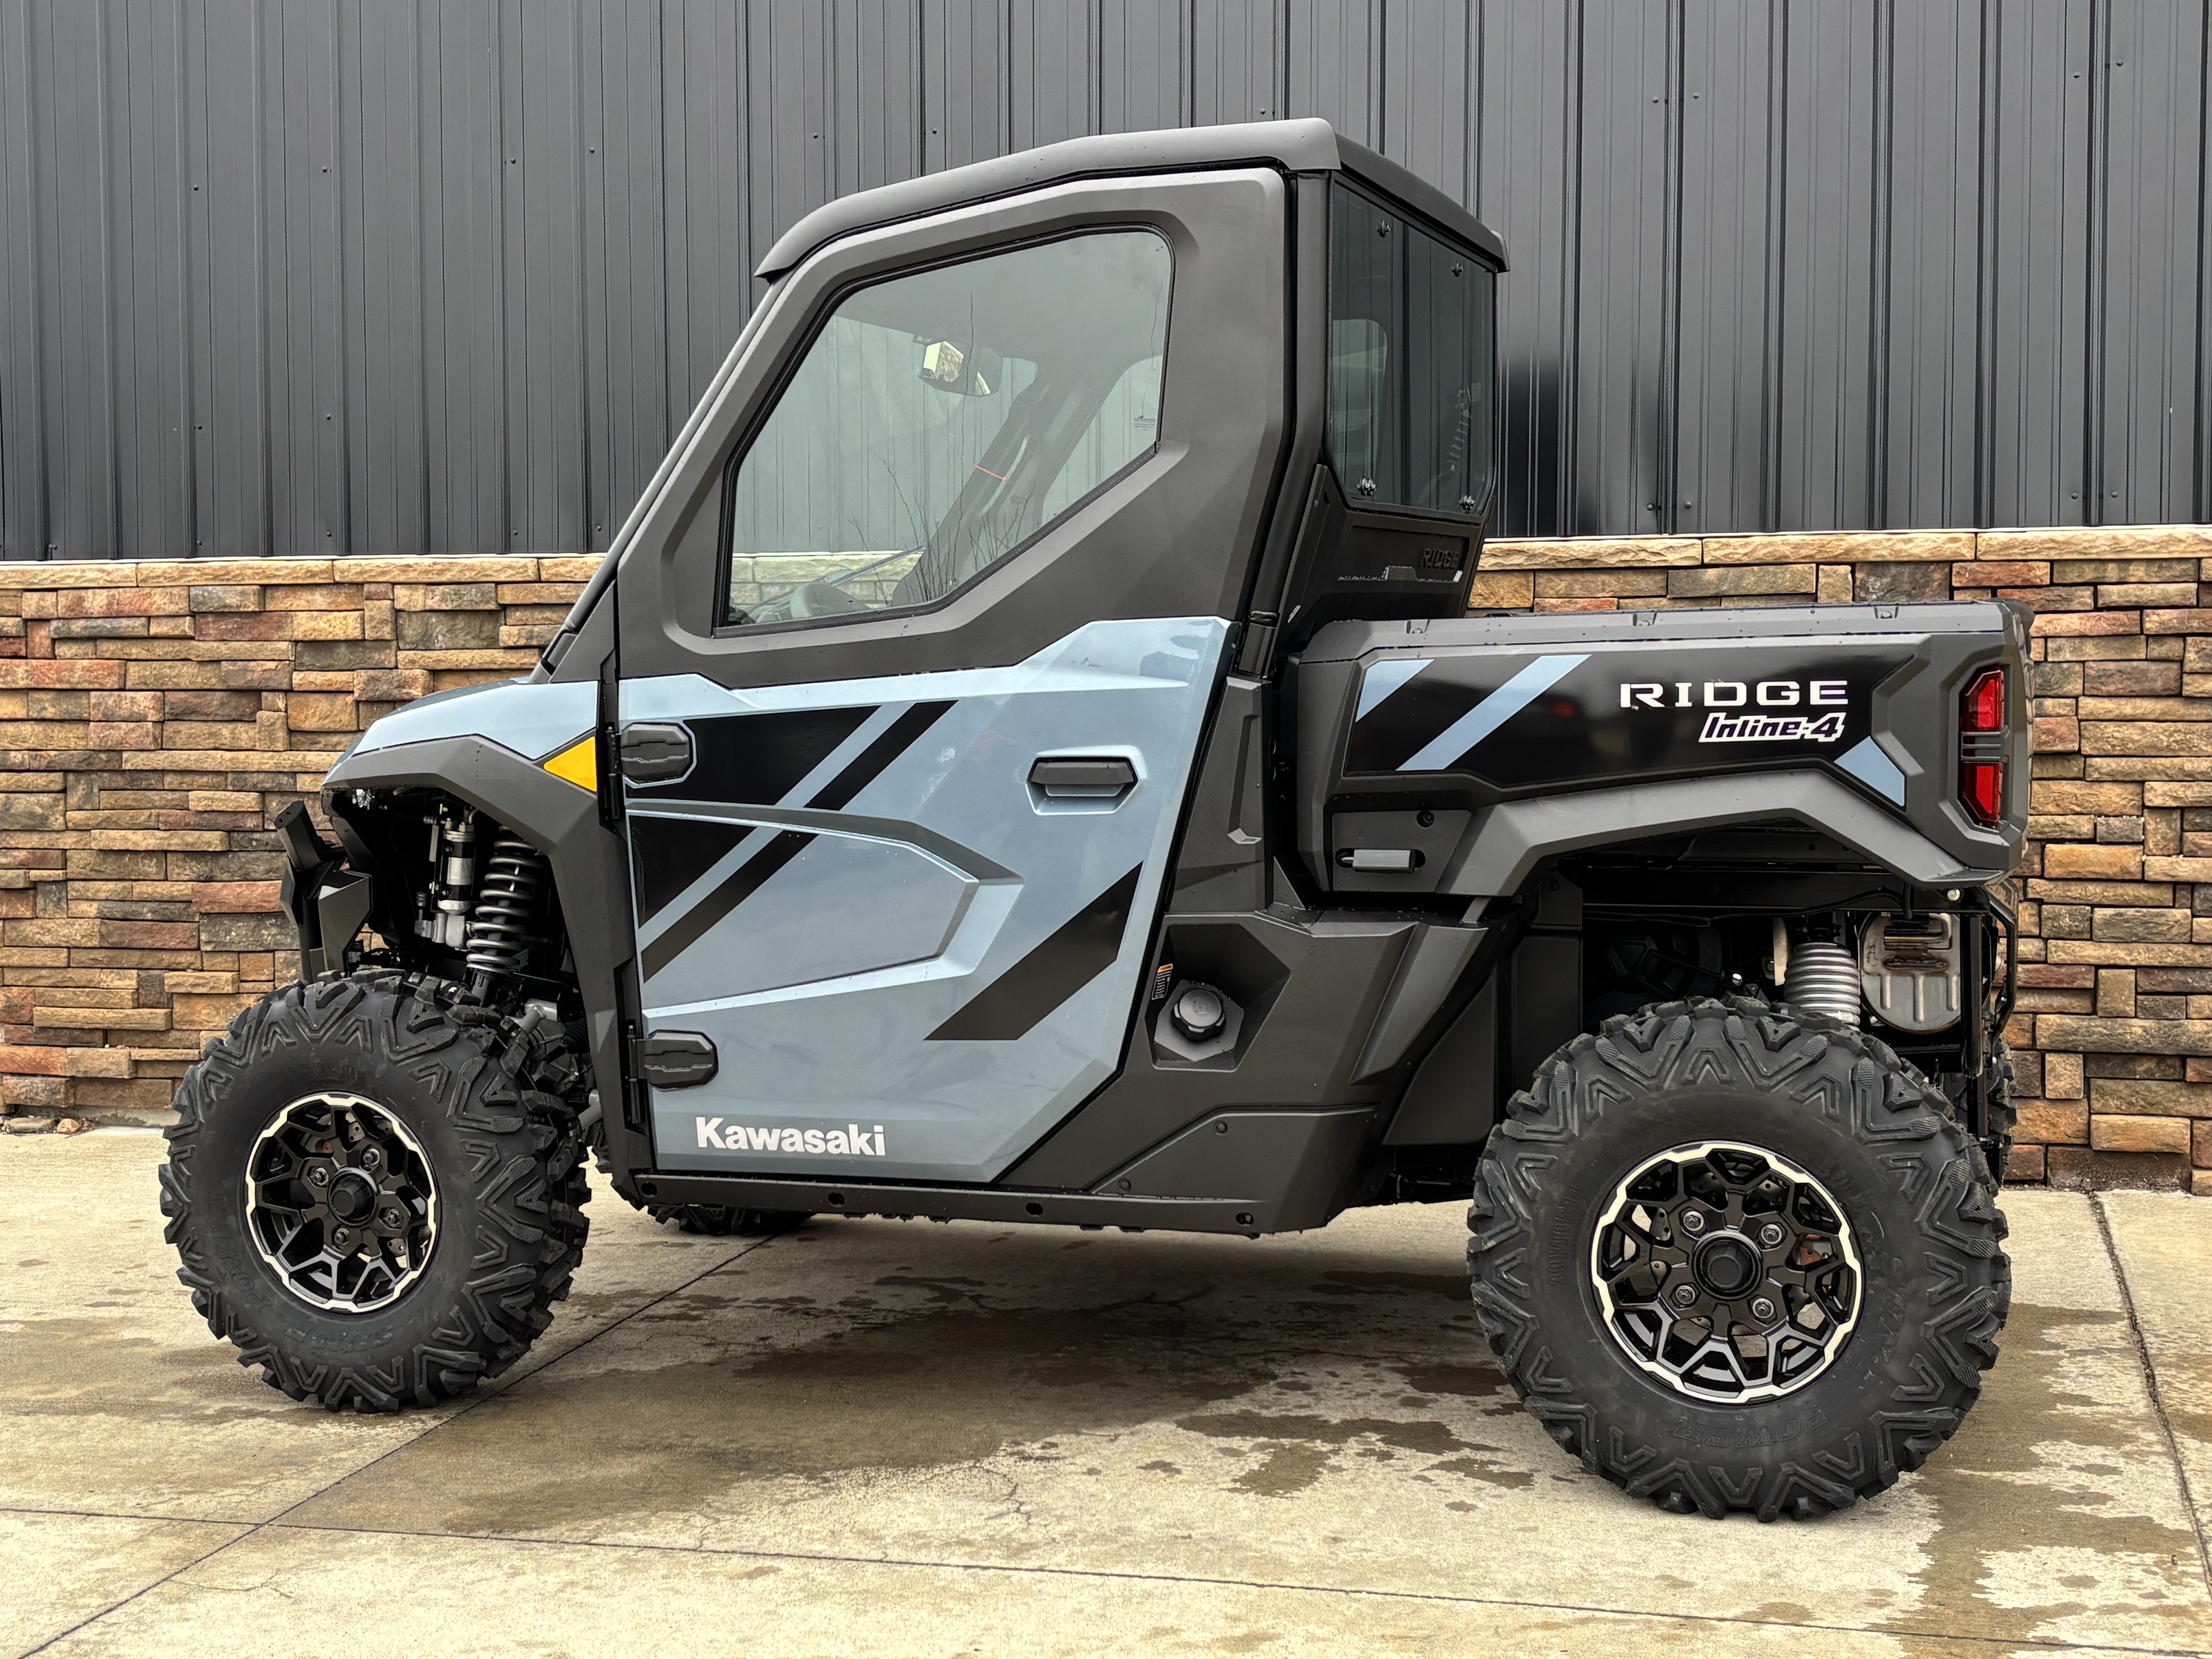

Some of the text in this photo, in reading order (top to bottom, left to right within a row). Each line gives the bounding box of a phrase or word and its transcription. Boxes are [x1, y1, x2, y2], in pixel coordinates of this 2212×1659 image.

[1418, 547, 1461, 569] RIDGE
[1620, 680, 1848, 708] RIDGE
[1698, 712, 1846, 743] Inline-4
[696, 1116, 886, 1156] Kawasaki
